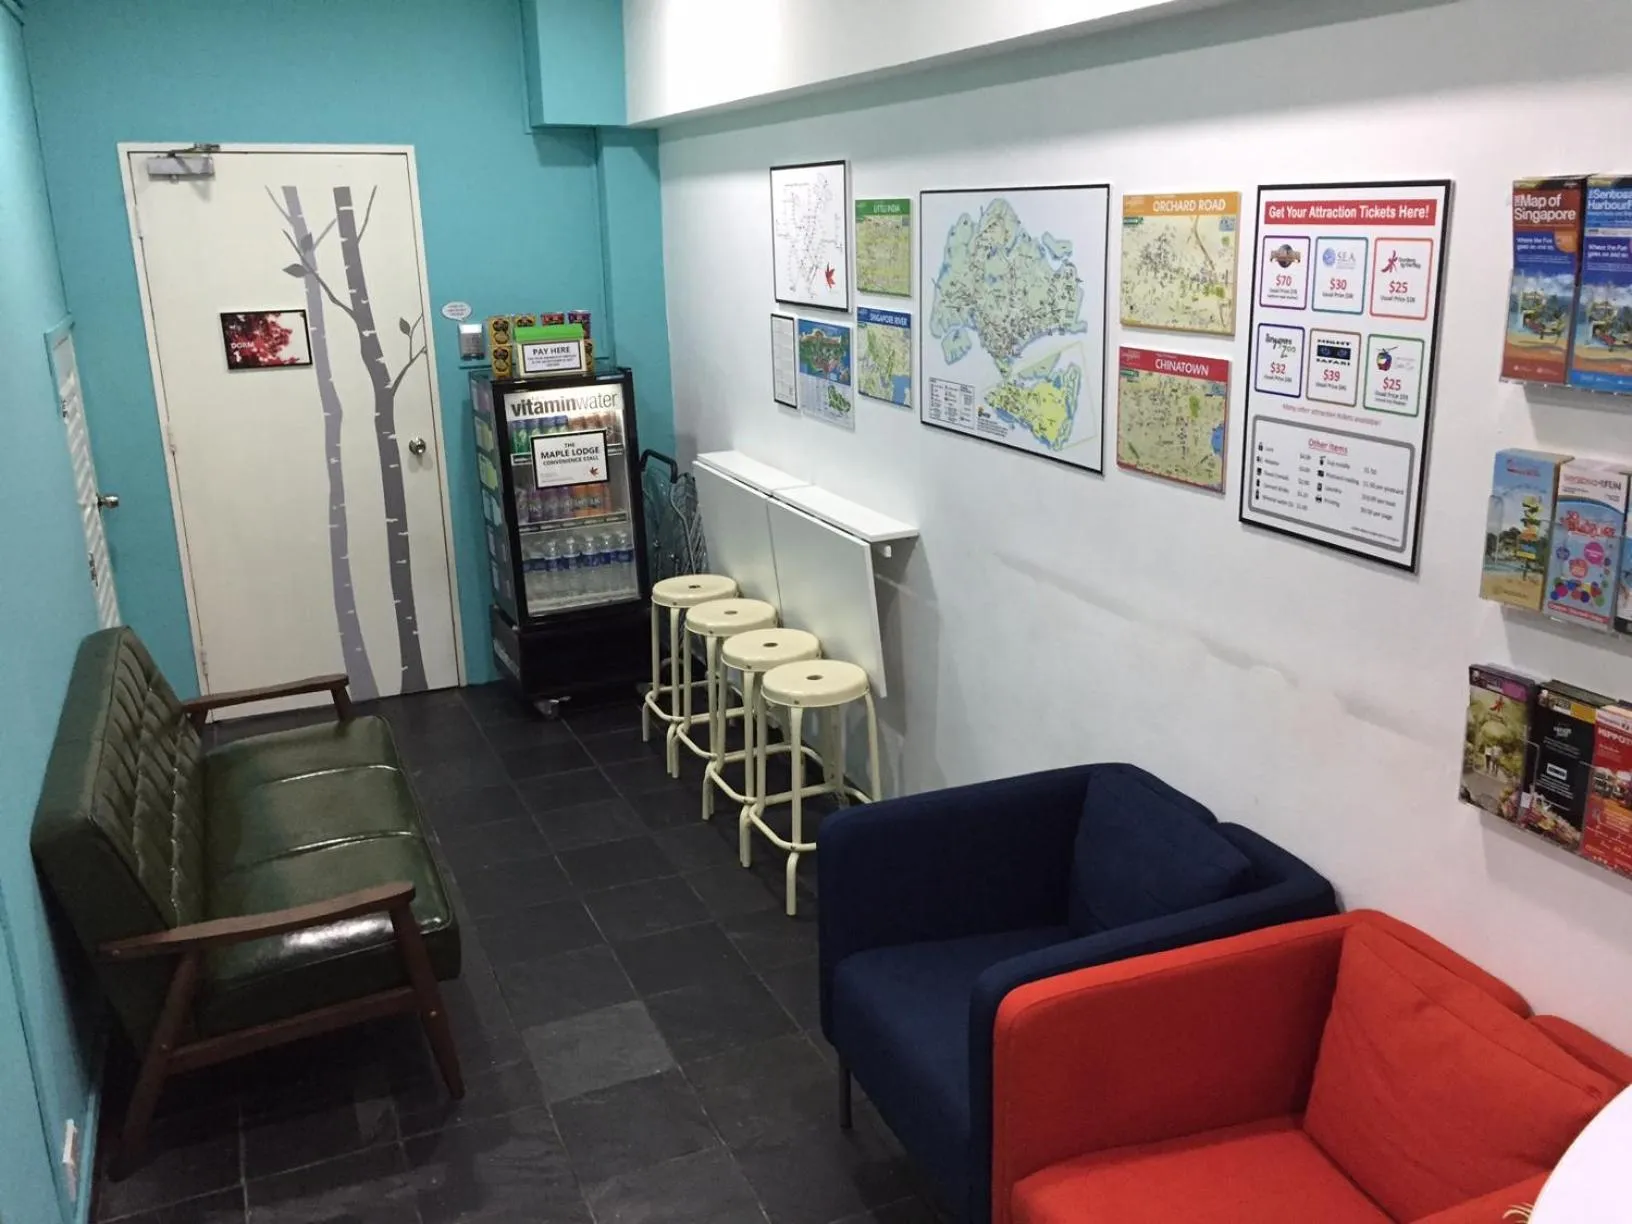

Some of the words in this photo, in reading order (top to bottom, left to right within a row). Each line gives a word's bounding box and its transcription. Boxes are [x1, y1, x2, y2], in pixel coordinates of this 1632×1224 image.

[1153, 200, 1196, 212] ORCHARD
[1198, 199, 1226, 211] ROAD
[1521, 193, 1546, 209] Map
[1548, 193, 1562, 207] of
[1268, 205, 1284, 219] Get
[1286, 205, 1307, 218] Your
[1308, 205, 1357, 218] Attraction
[1359, 204, 1396, 218] Tickets
[1398, 205, 1430, 219] Here!
[1514, 208, 1576, 224] Singapore
[1276, 274, 1292, 287] $70
[1330, 278, 1347, 291] $30
[1389, 281, 1408, 294] $25
[234, 351, 242, 362] 1
[532, 347, 548, 356] PAY
[551, 346, 570, 355] HERE
[1155, 358, 1209, 376] CHINATOWN
[1270, 362, 1286, 375] $32
[1323, 369, 1340, 382] $39
[1383, 377, 1401, 391] $25
[511, 392, 618, 417] vitaminwater
[1309, 438, 1327, 449] Other
[540, 449, 569, 460] MAPLE
[571, 446, 600, 456] LODGE
[543, 456, 582, 466] CONVENIENCE
